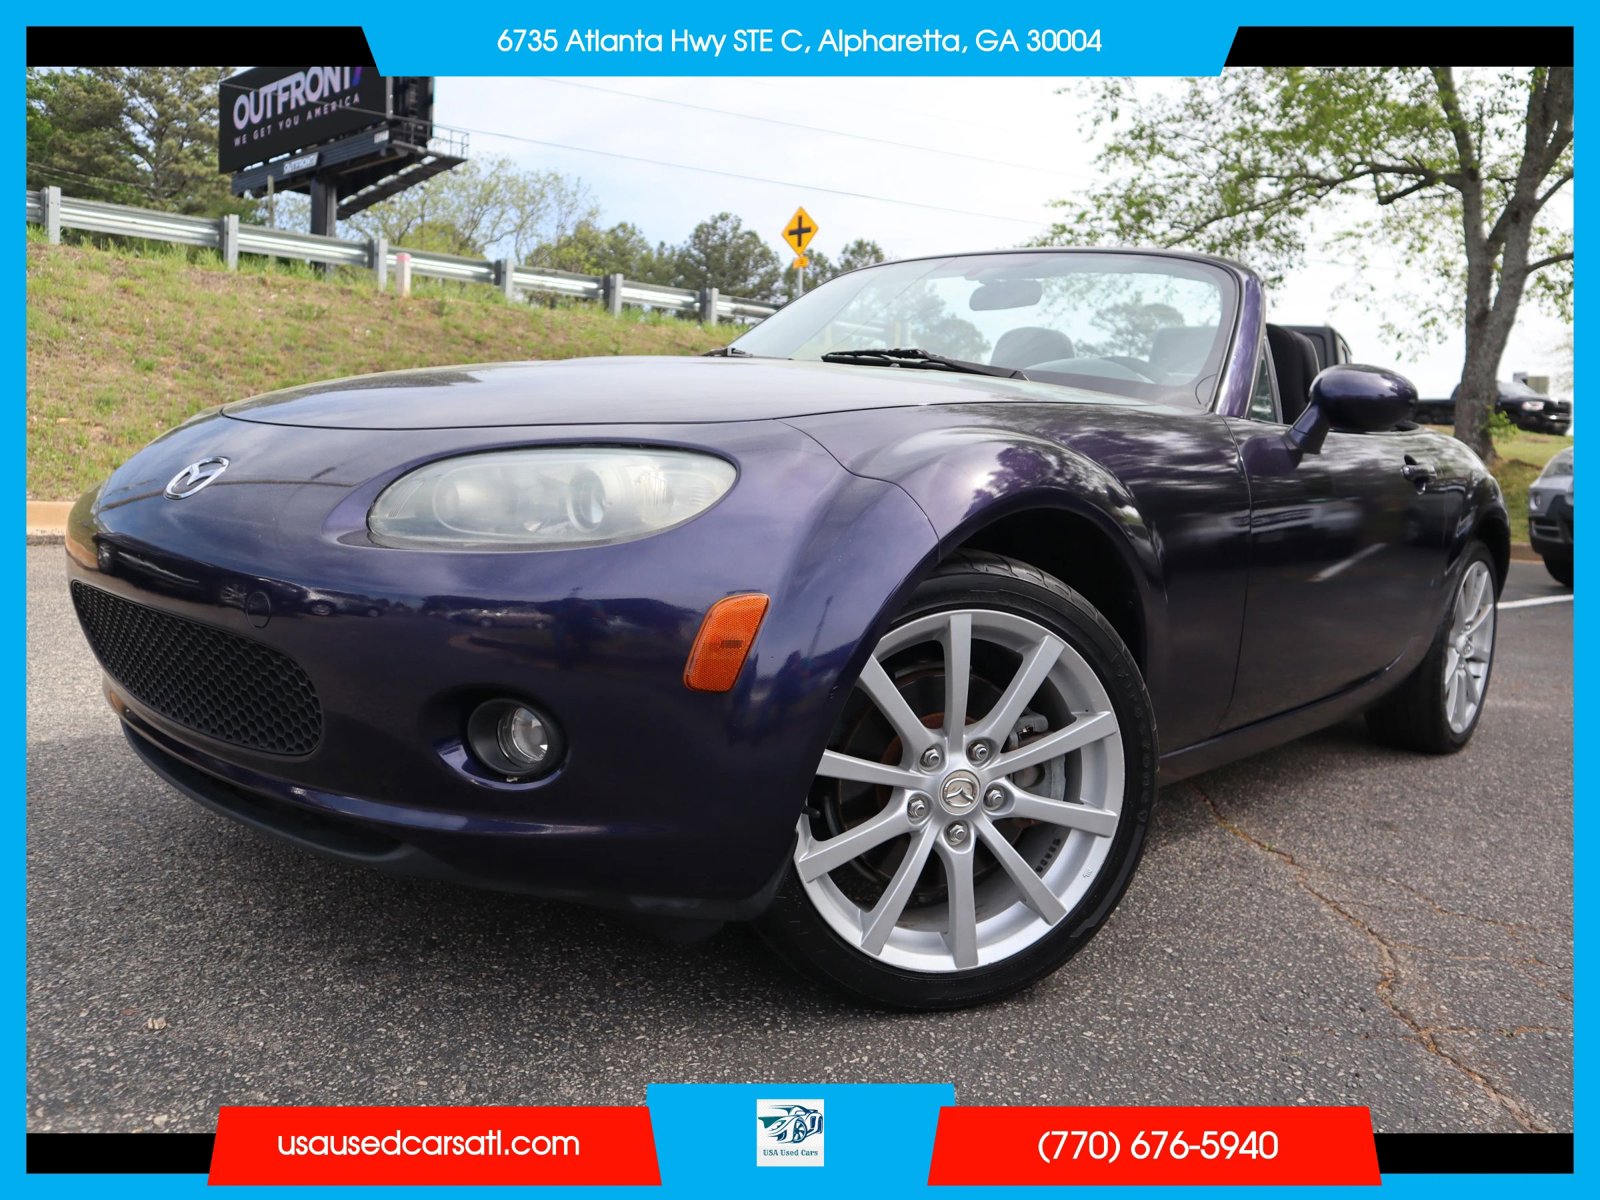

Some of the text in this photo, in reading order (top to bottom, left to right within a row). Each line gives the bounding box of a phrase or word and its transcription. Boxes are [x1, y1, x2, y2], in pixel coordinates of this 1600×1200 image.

[234, 93, 360, 147] WE GET YOU AMERICA
